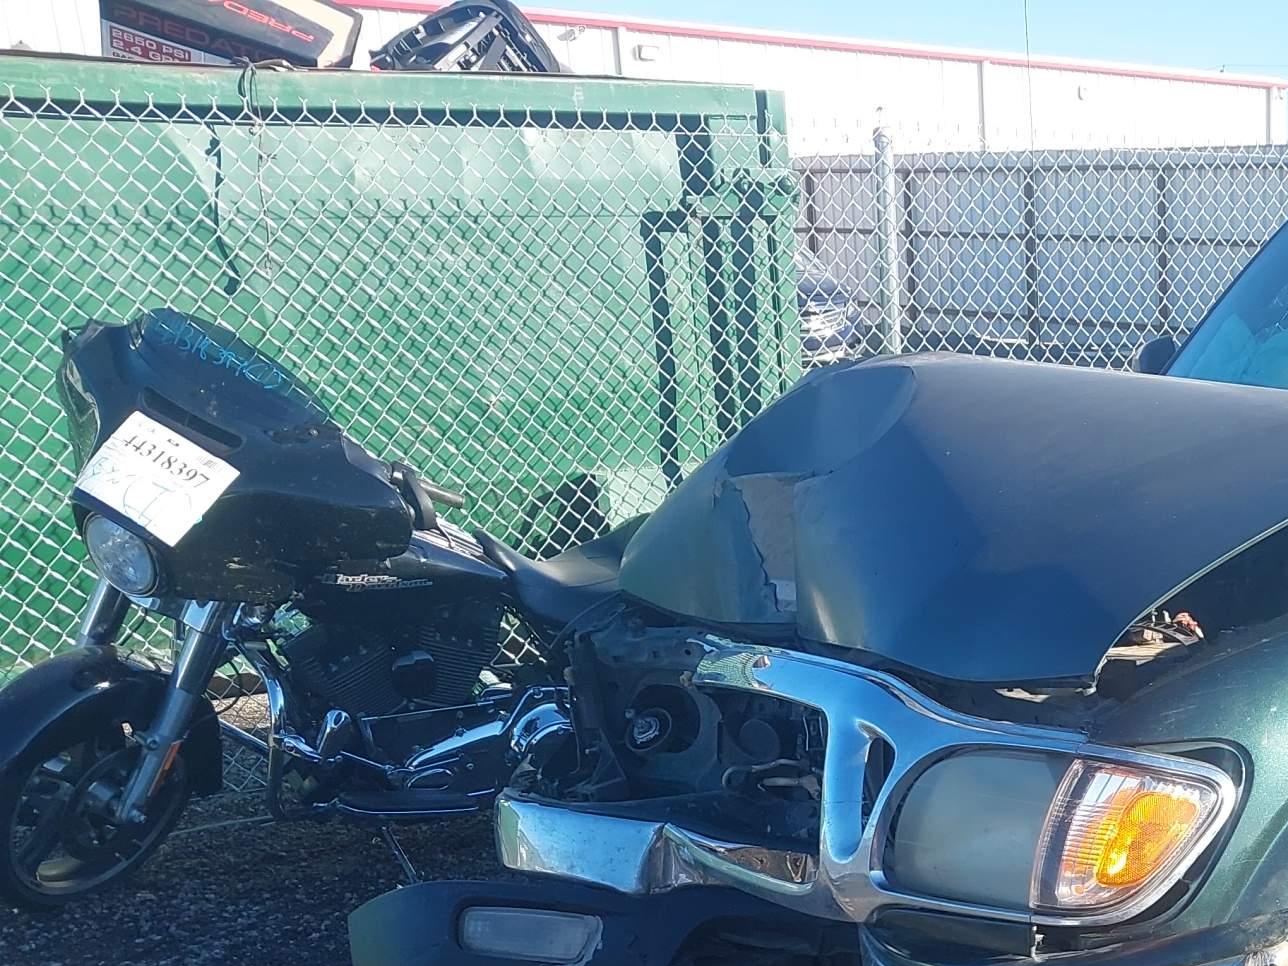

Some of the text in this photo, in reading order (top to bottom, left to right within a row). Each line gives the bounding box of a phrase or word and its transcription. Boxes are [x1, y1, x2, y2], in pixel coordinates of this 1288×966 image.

[112, 29, 190, 60] 2650 PSI
[124, 435, 210, 488] 44318397
